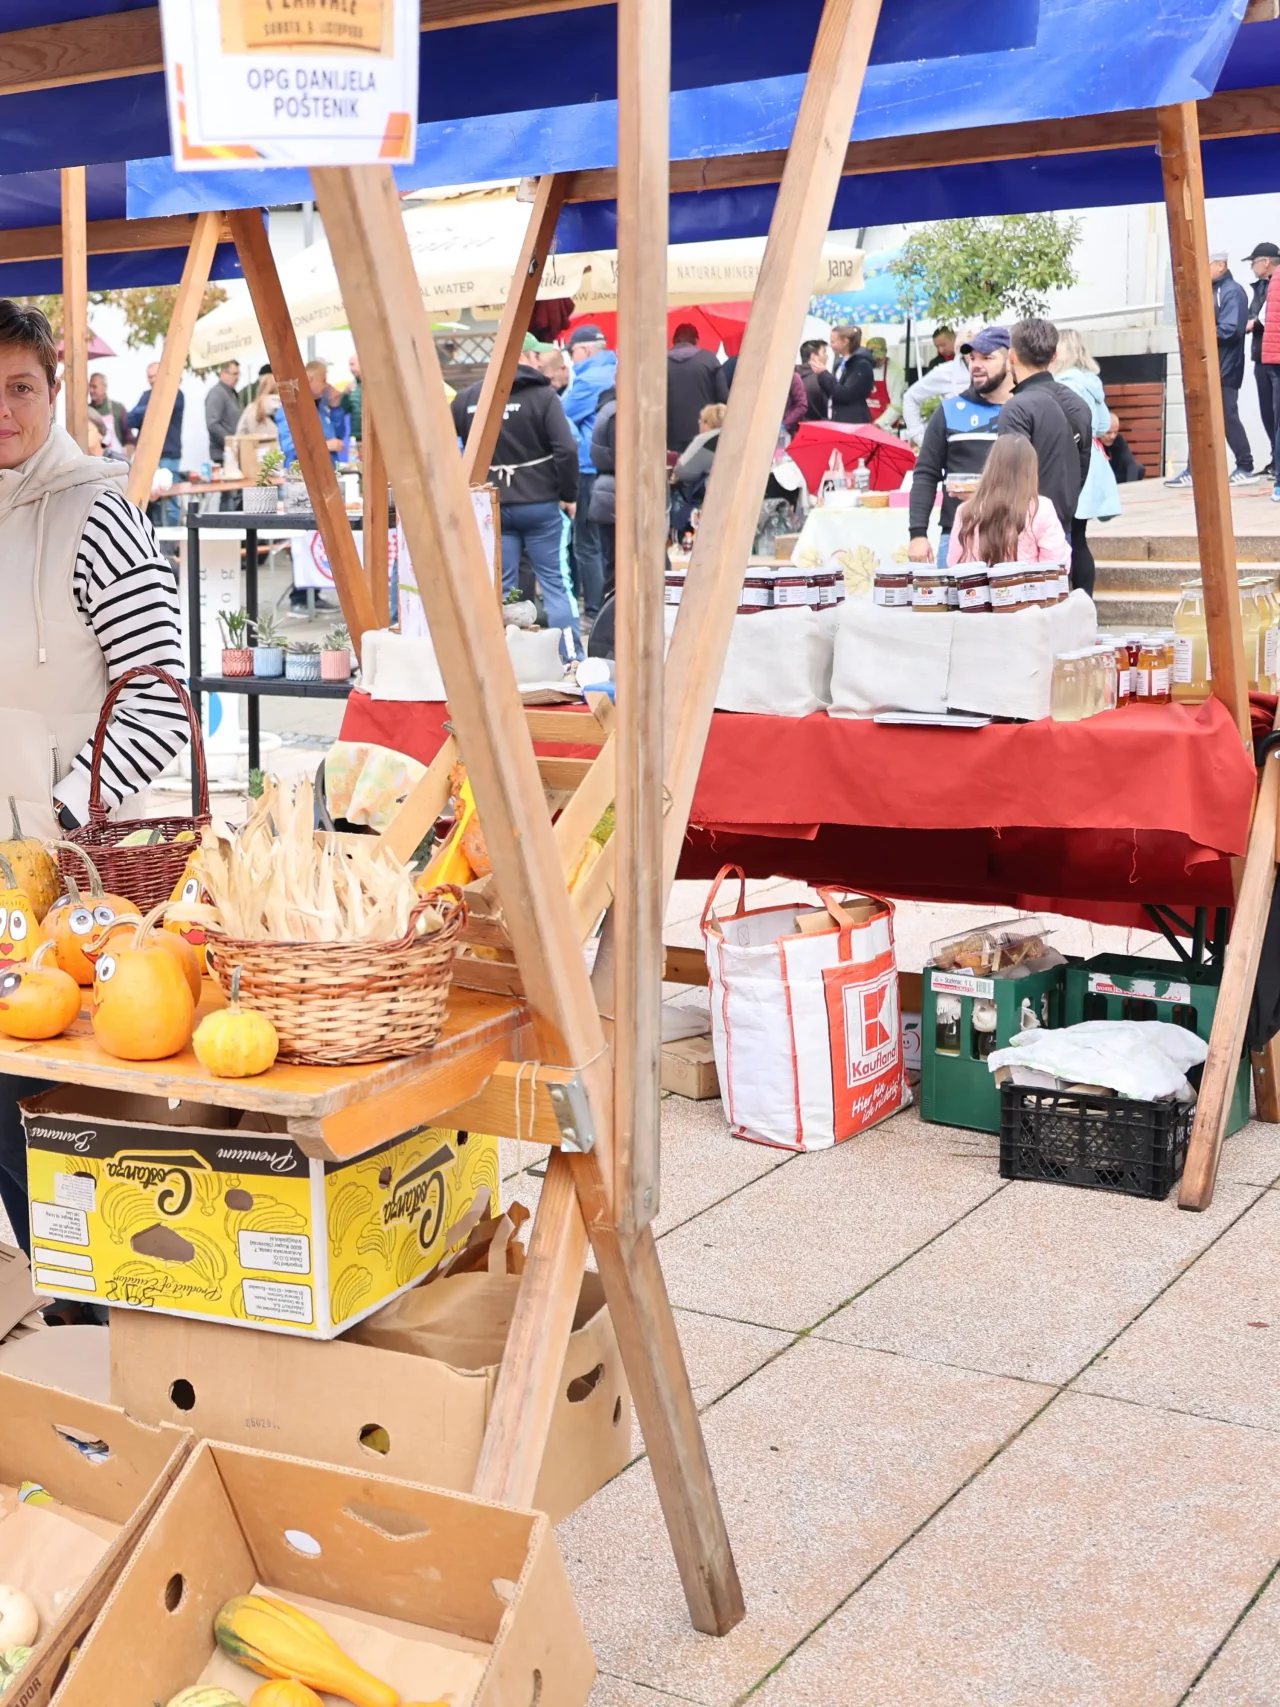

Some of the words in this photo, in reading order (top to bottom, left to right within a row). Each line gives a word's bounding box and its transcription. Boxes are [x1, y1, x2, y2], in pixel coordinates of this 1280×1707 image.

[247, 68, 289, 90] OPG
[297, 69, 376, 92] DANIJELA
[274, 93, 359, 118] POŠTENIK
[677, 265, 721, 280] NATURAL
[433, 282, 474, 295] WATER
[852, 1041, 896, 1079] Kaufland
[852, 1093, 871, 1117] Hier
[872, 1081, 886, 1101] bin
[29, 1127, 96, 1151] Bananas
[216, 1147, 297, 1172] Premium
[106, 1160, 192, 1216] Costanza
[383, 1171, 444, 1249] Costanza
[113, 1276, 158, 1291] Ecuador
[160, 1276, 170, 1292] of
[175, 1284, 221, 1301] Product
[15, 1677, 42, 1707] DOR
